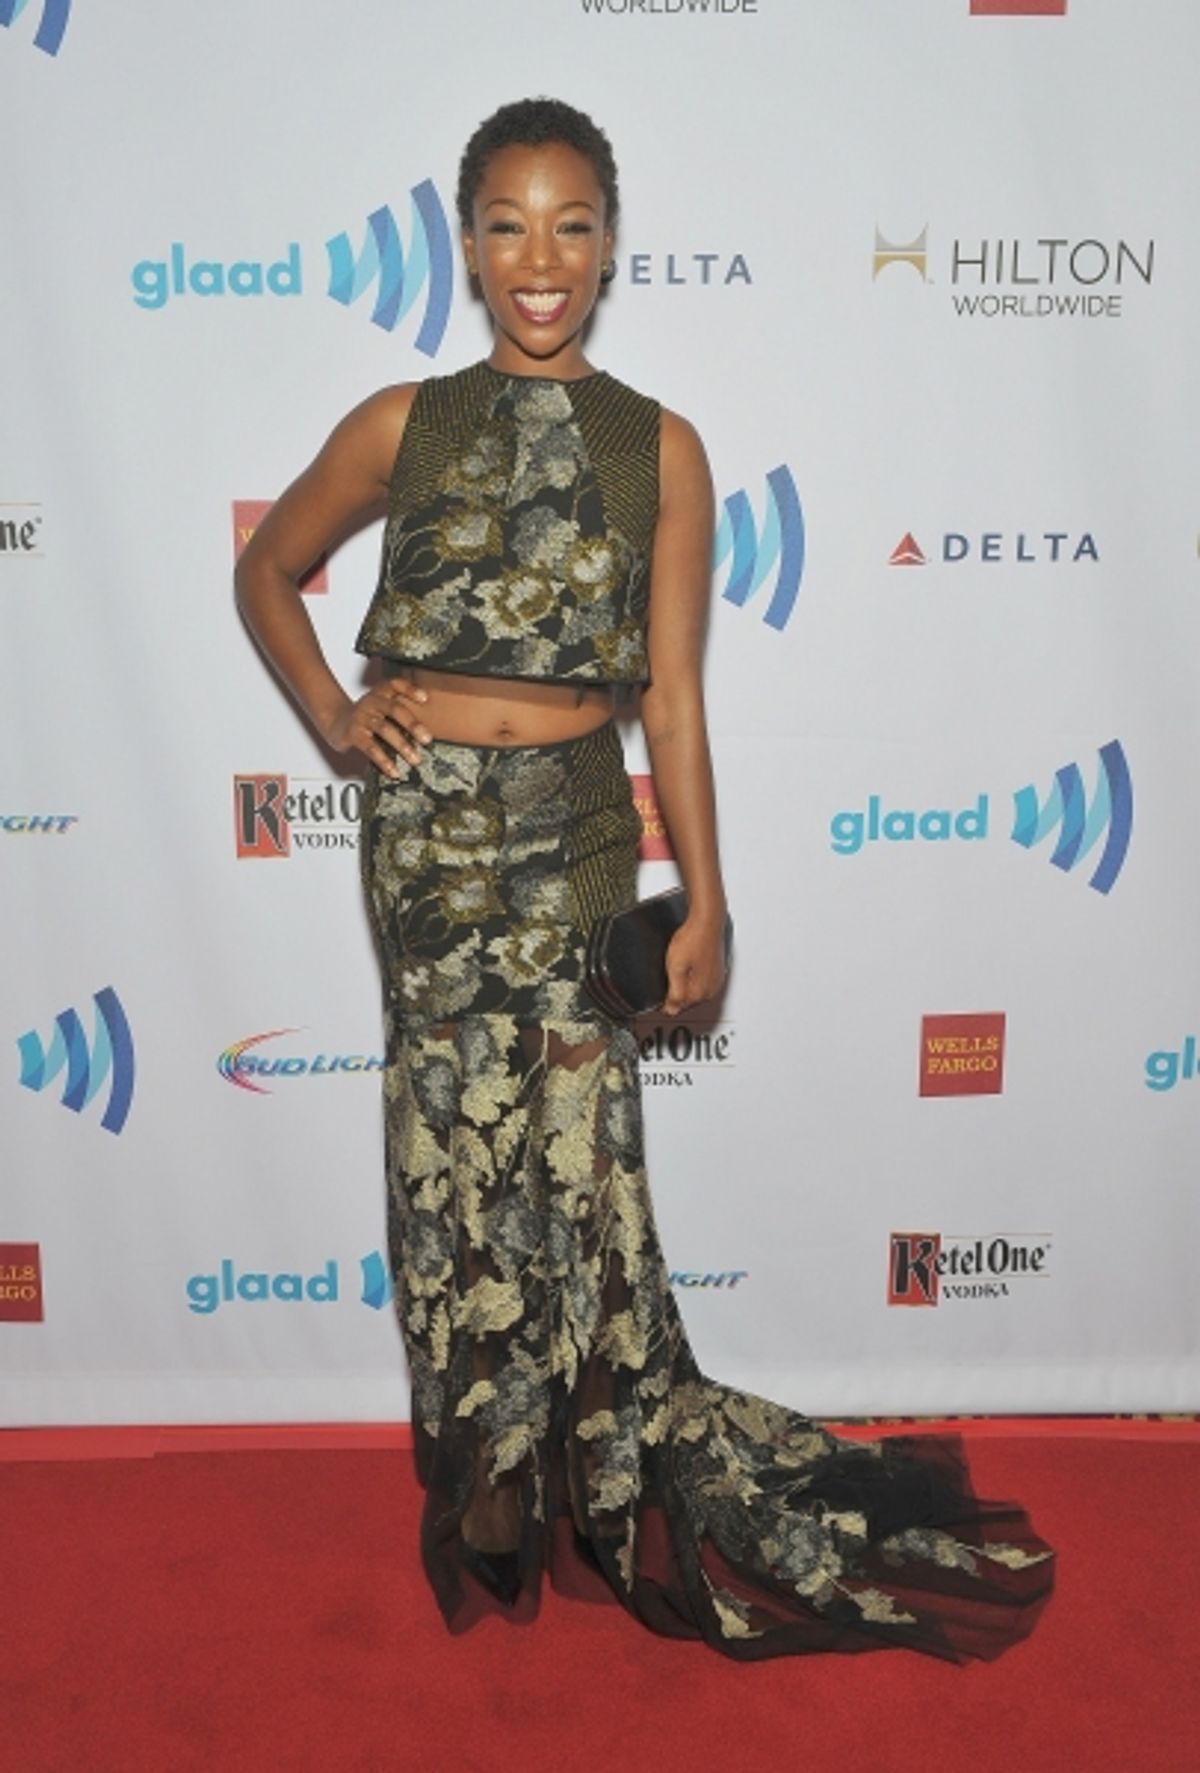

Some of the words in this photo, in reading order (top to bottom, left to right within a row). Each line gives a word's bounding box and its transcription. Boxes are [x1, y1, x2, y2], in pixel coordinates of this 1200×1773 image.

[629, 254, 753, 285] ELTA
[952, 239, 1155, 284] HILTON
[132, 242, 302, 310] glaad
[952, 295, 1122, 317] WORLDWIDE
[943, 534, 1099, 562] DELTA
[0, 815, 79, 834] GHT
[238, 780, 335, 851] Ketel
[831, 794, 988, 855] glaad
[292, 833, 361, 849] VODK
[927, 1035, 999, 1054] WELLS
[235, 1054, 308, 1077] BUD
[309, 1053, 386, 1075] LIGH
[927, 1056, 998, 1074] FARGO
[1145, 1036, 1200, 1091] gl
[638, 1073, 693, 1087] ODKA
[667, 1270, 749, 1289] IGHT
[893, 1240, 983, 1300] Ketel
[186, 1259, 338, 1314] glaad
[942, 1282, 1010, 1299] VODKA
